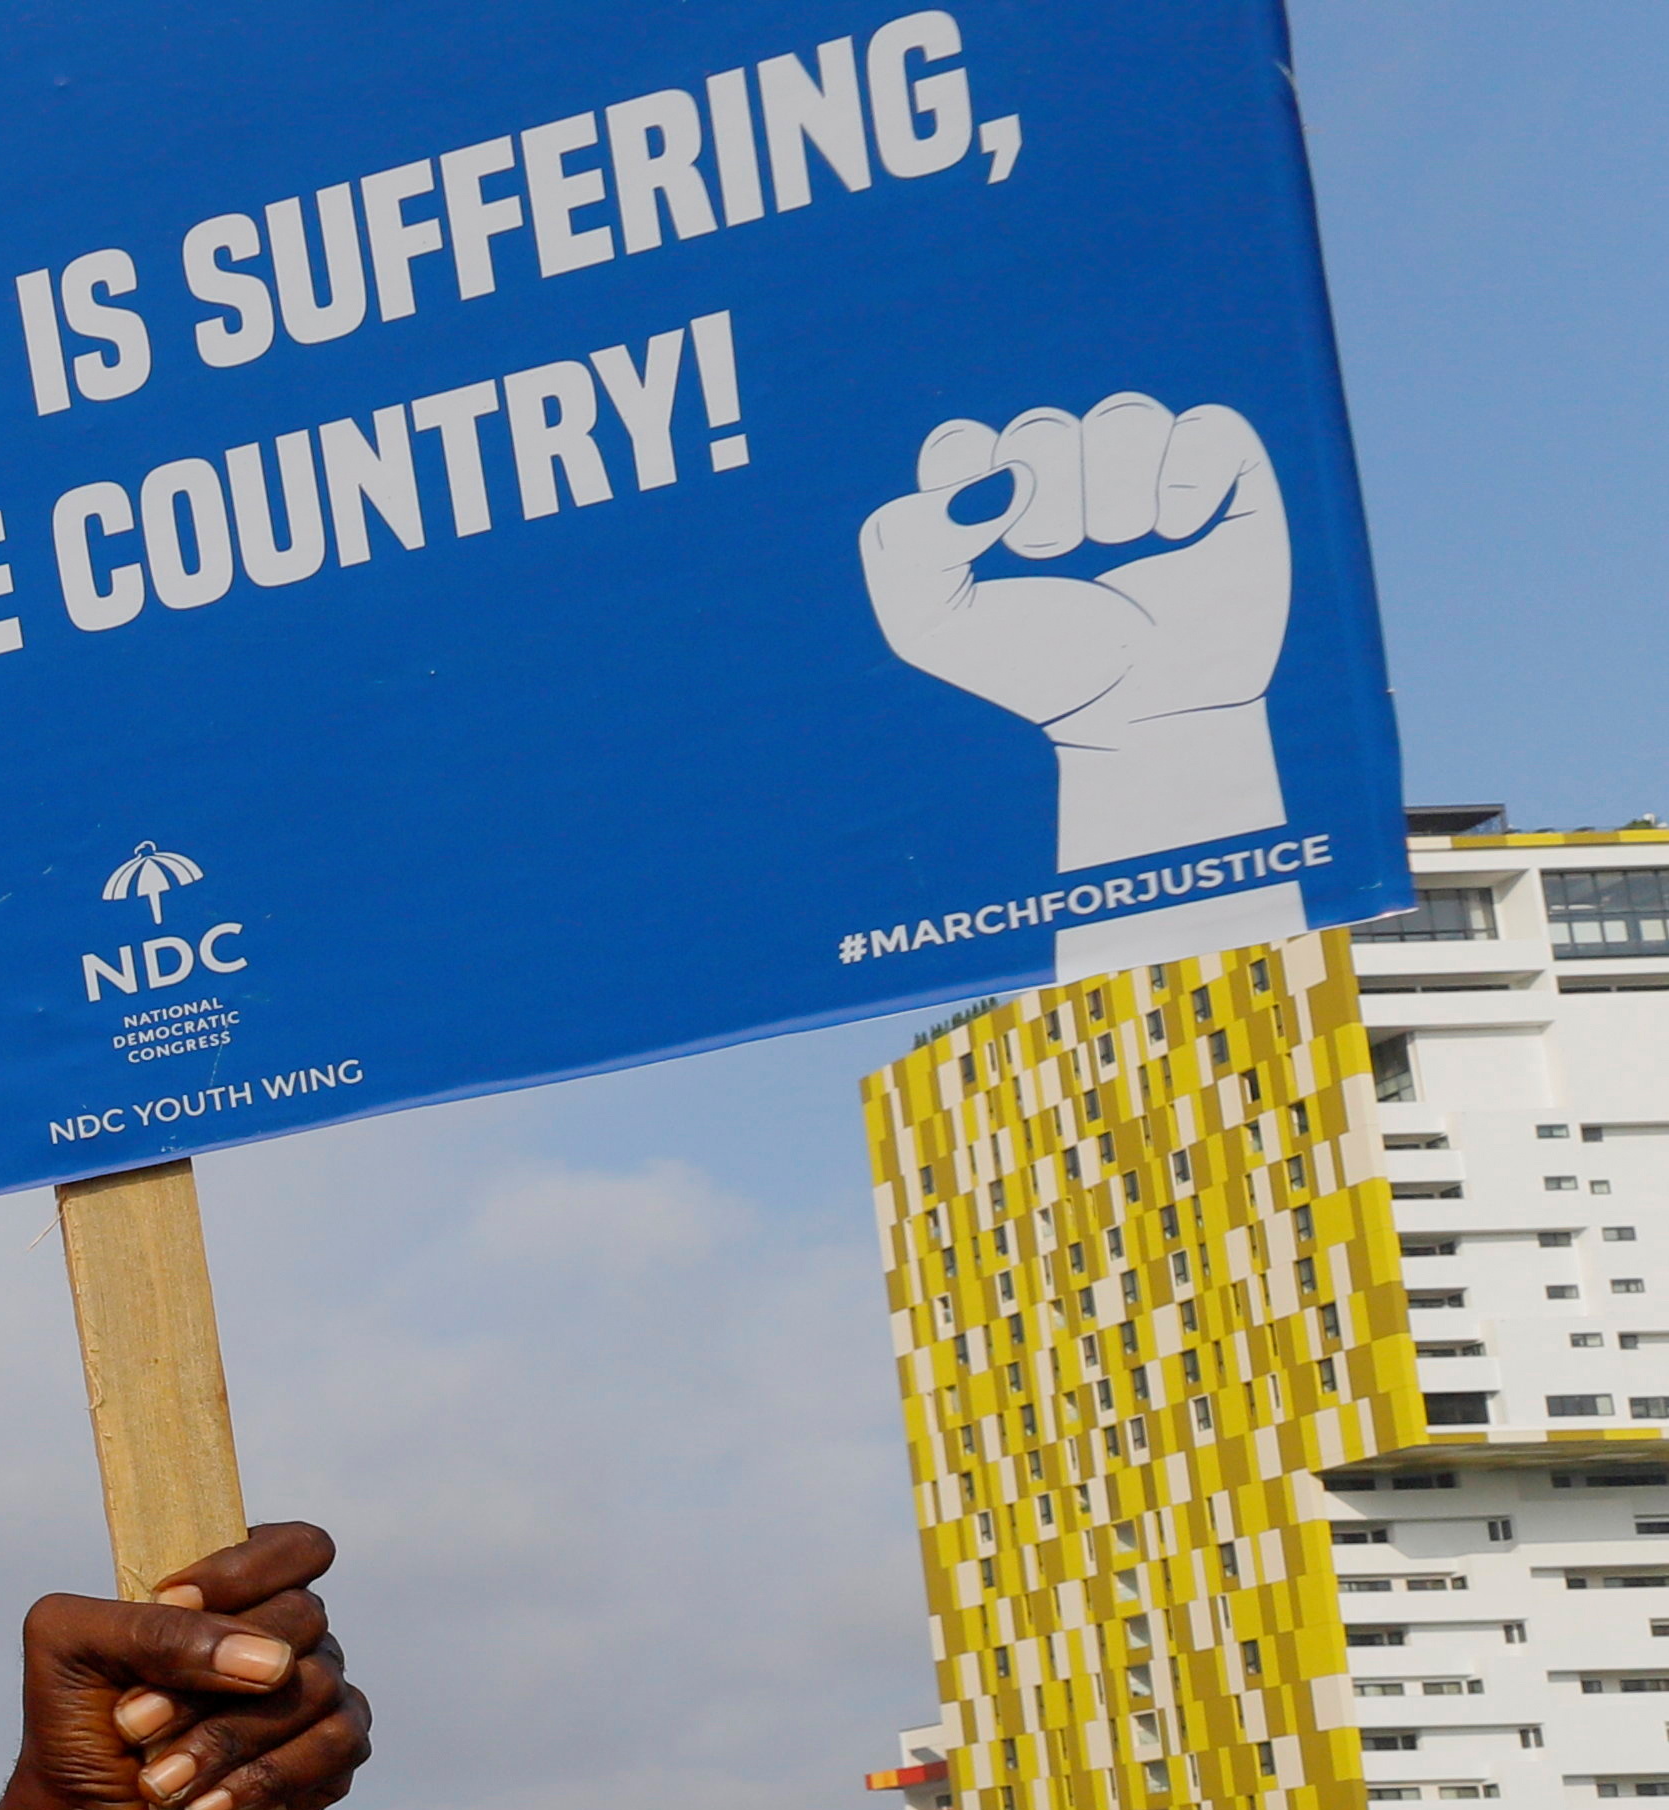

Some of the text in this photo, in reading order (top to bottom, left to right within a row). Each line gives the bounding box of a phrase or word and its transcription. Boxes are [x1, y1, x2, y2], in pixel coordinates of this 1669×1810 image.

[16, 248, 151, 416] IS
[182, 9, 1023, 368] SUFFERING,
[52, 309, 751, 633] COUNTRY!
[838, 833, 1333, 965] #MARCHFORJUSTICE
[81, 922, 248, 1002] NDC
[112, 1010, 241, 1049] DEMOCRATIC
[123, 997, 224, 1028] NATIONAL
[127, 1031, 231, 1064] CONGRESS
[49, 1059, 364, 1144] NDC YOUTH WING
